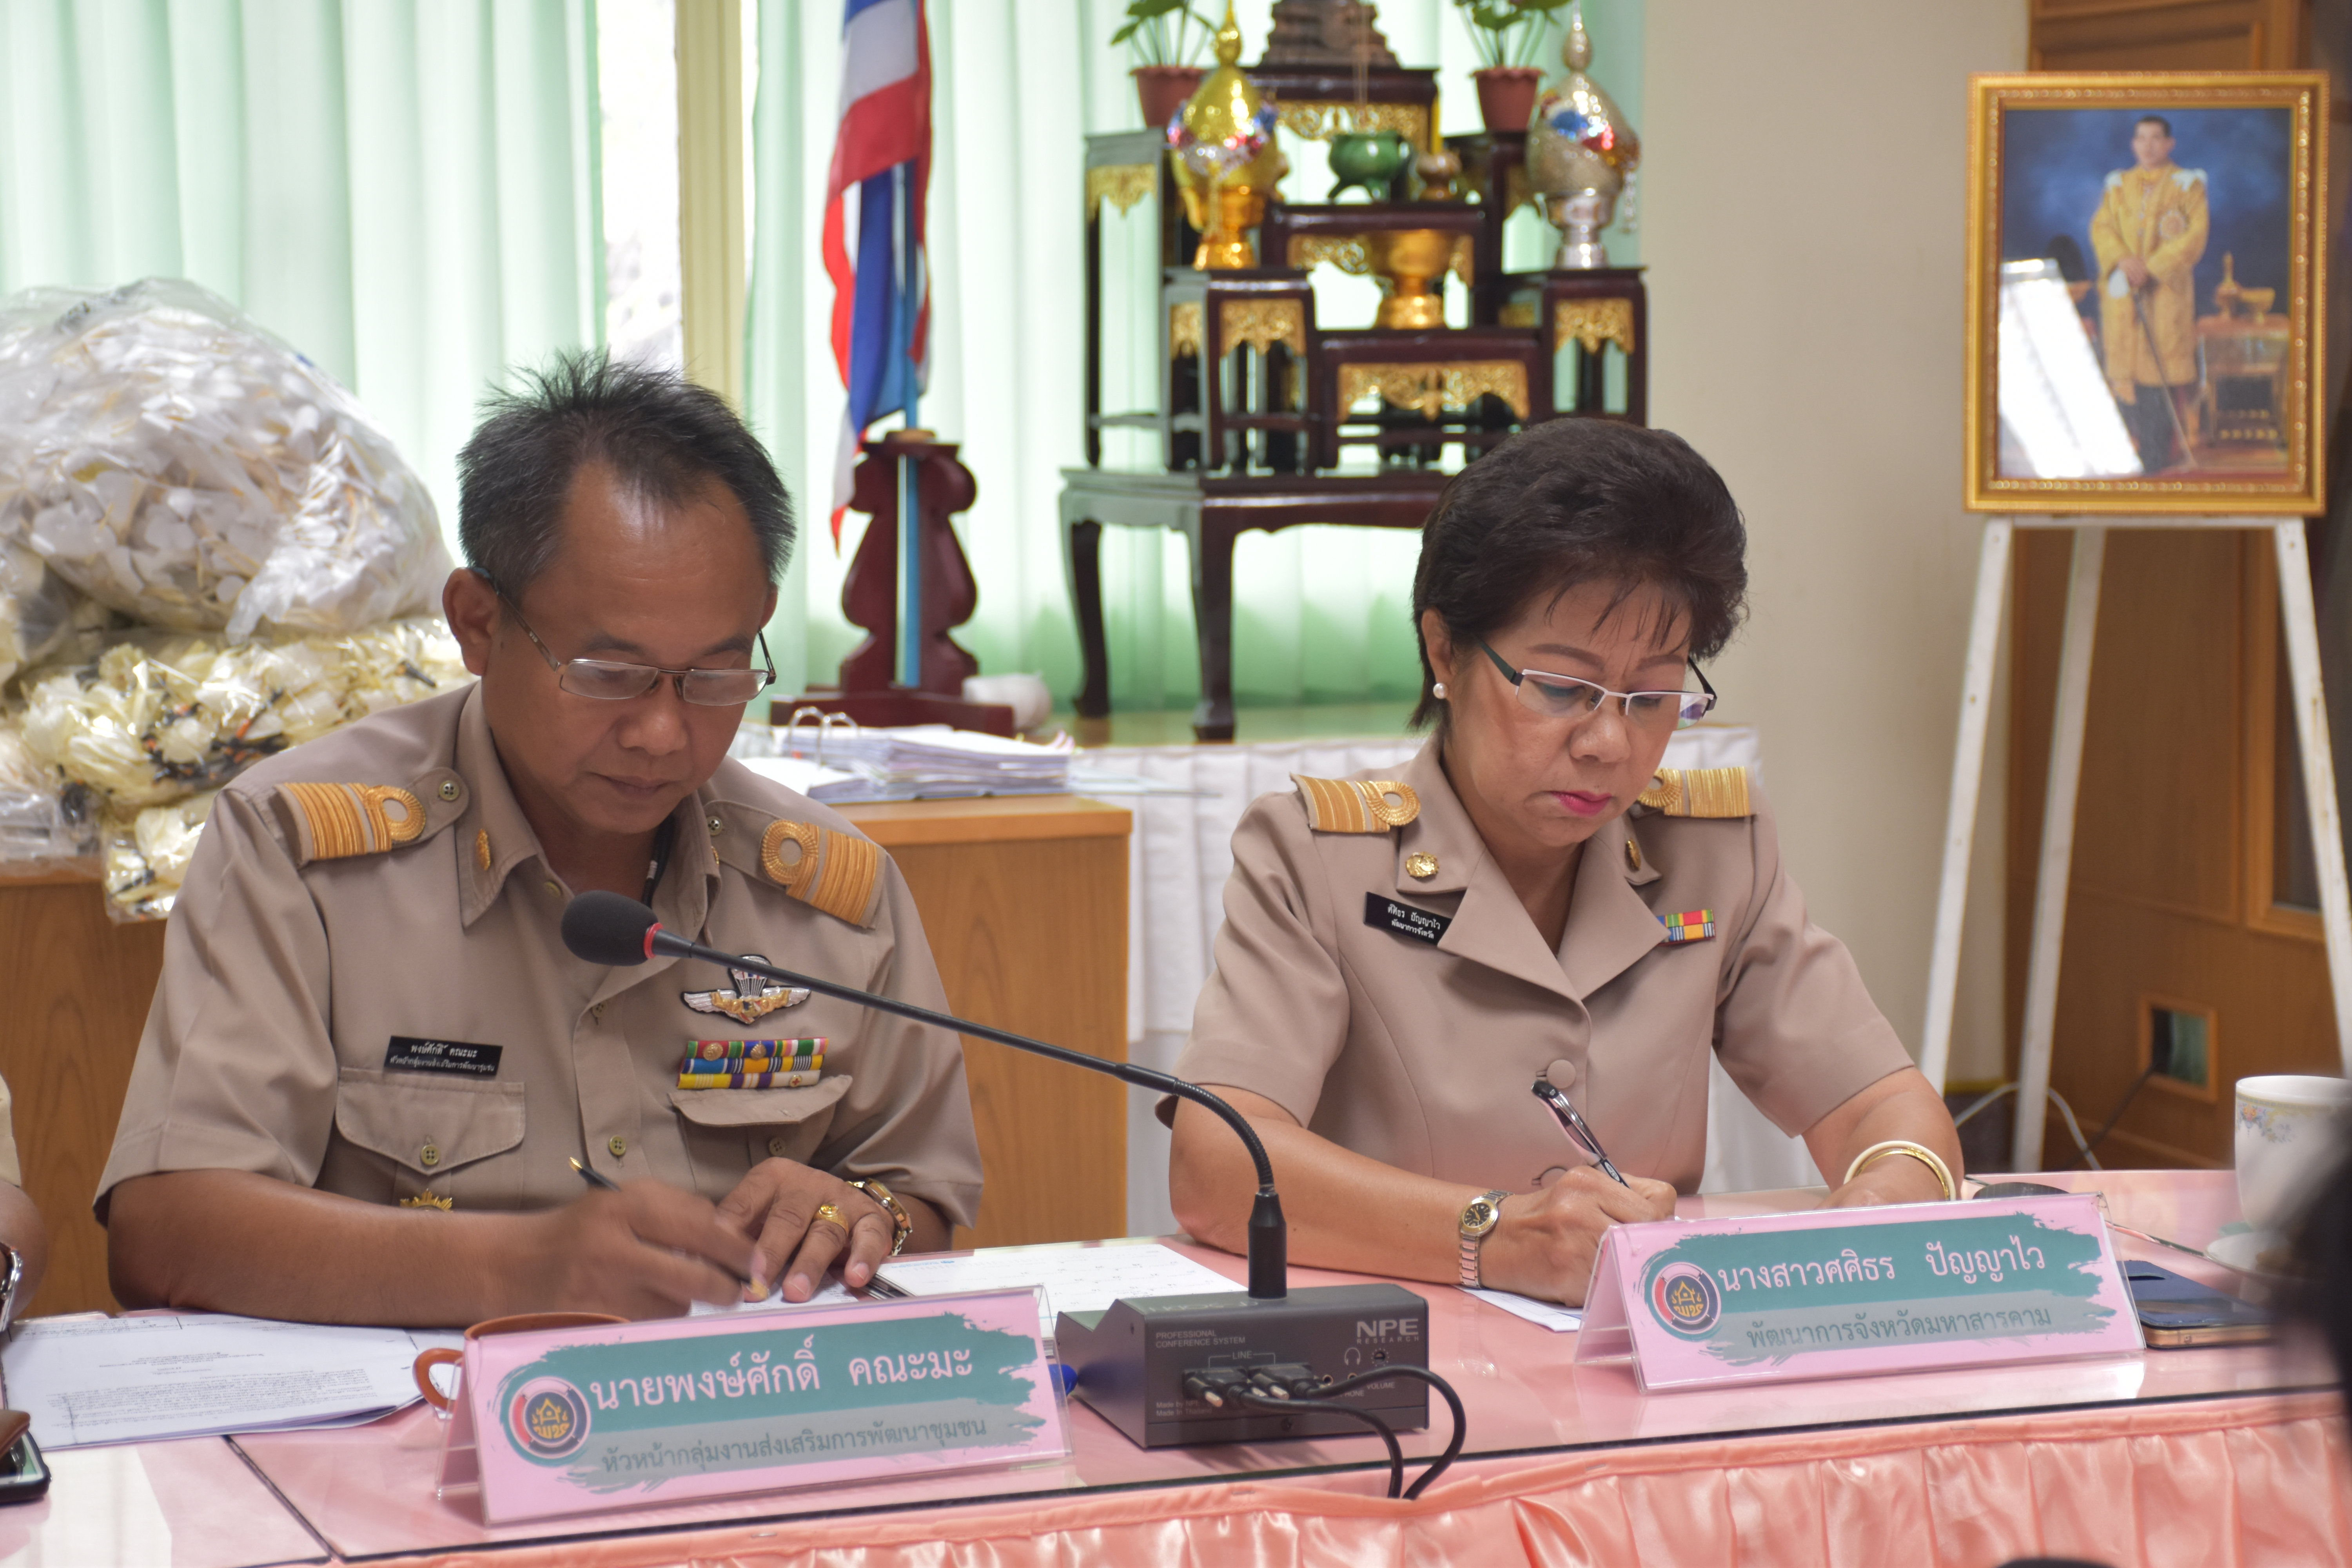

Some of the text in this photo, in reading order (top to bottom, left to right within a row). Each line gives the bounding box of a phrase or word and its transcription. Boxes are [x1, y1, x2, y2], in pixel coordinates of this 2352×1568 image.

[1718, 1235, 2045, 1291] นางสาวศศิธร ปัญญาไว
[1156, 1330, 1216, 1339] PROFESSIONAL
[1357, 1319, 1418, 1338] NPE
[1746, 1307, 2052, 1348] พัฒนาการจังหวัดมหาสารคาม
[1156, 1337, 1245, 1348] CONFERENCE SYSTEM
[1357, 1336, 1419, 1345] RESEARCH
[1232, 1350, 1252, 1359] LINE
[590, 1334, 972, 1410] นายพงษ์ศักดิ์ คณะมะ
[601, 1419, 987, 1473] หัวหน้ากลุ่มงานส่งเสริมการพัฒนาชุมชน
